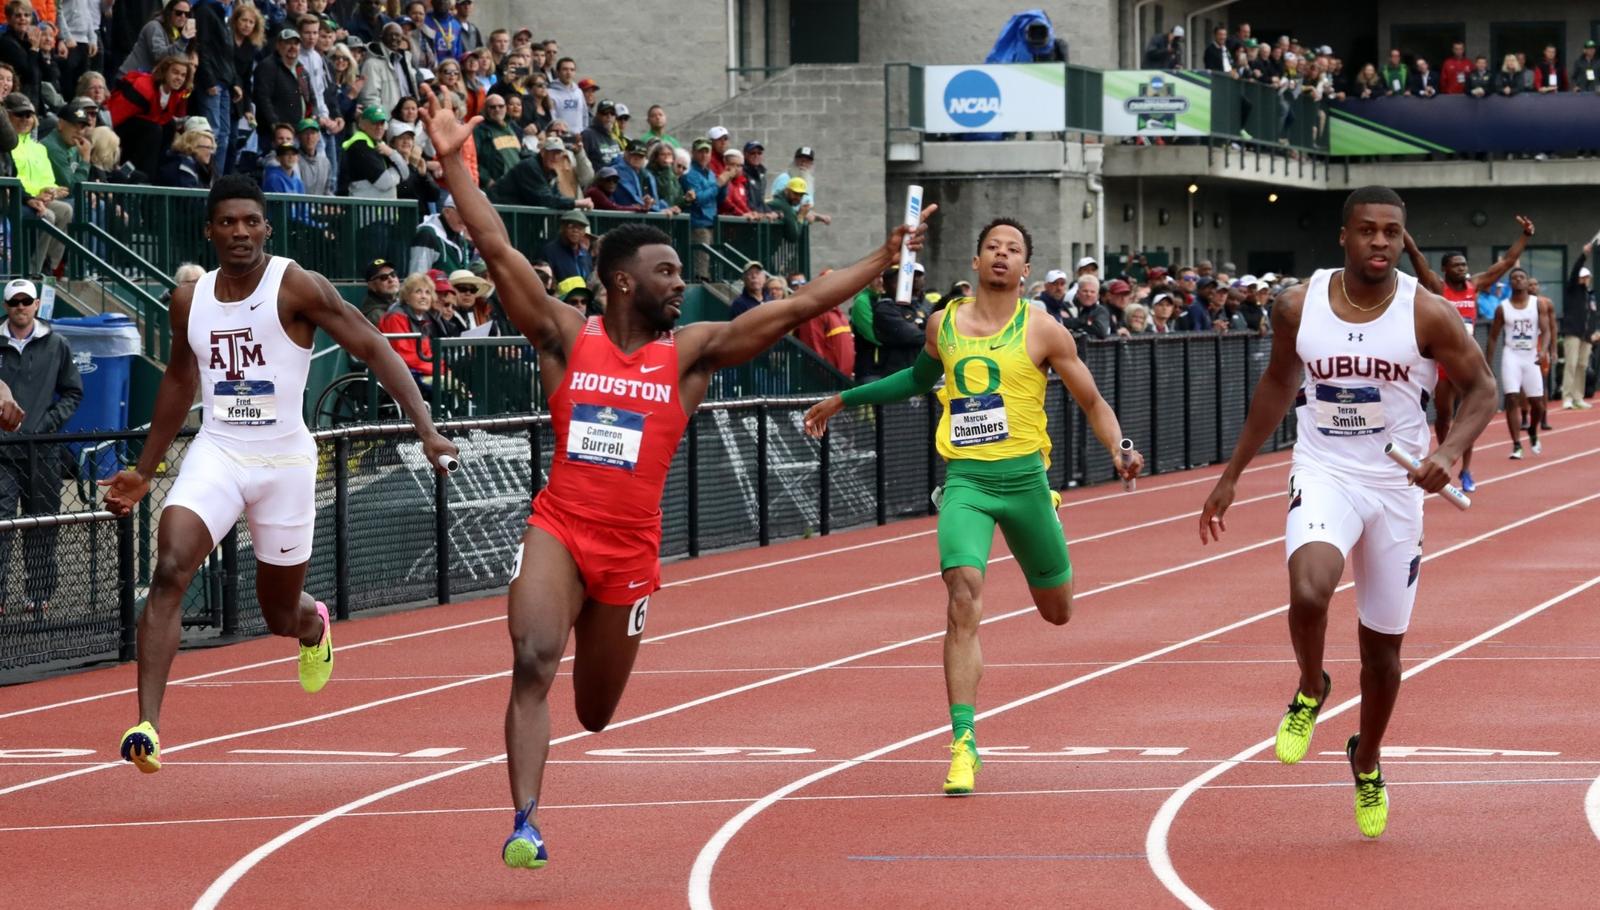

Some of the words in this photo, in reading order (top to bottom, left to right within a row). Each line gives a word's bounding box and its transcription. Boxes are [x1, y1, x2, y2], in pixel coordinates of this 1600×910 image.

[949, 97, 1000, 114] NCAA
[953, 356, 1001, 396] O
[569, 371, 672, 403] HOUSTON
[236, 398, 251, 406] Fred
[228, 407, 262, 418] Kerley
[1337, 406, 1358, 415] Teray
[963, 414, 988, 423] Marcus
[1332, 415, 1366, 427] Smith
[587, 426, 623, 440] Cameron
[954, 421, 1004, 438] Chambers
[581, 437, 624, 456] Burrell
[634, 598, 647, 632] 6
